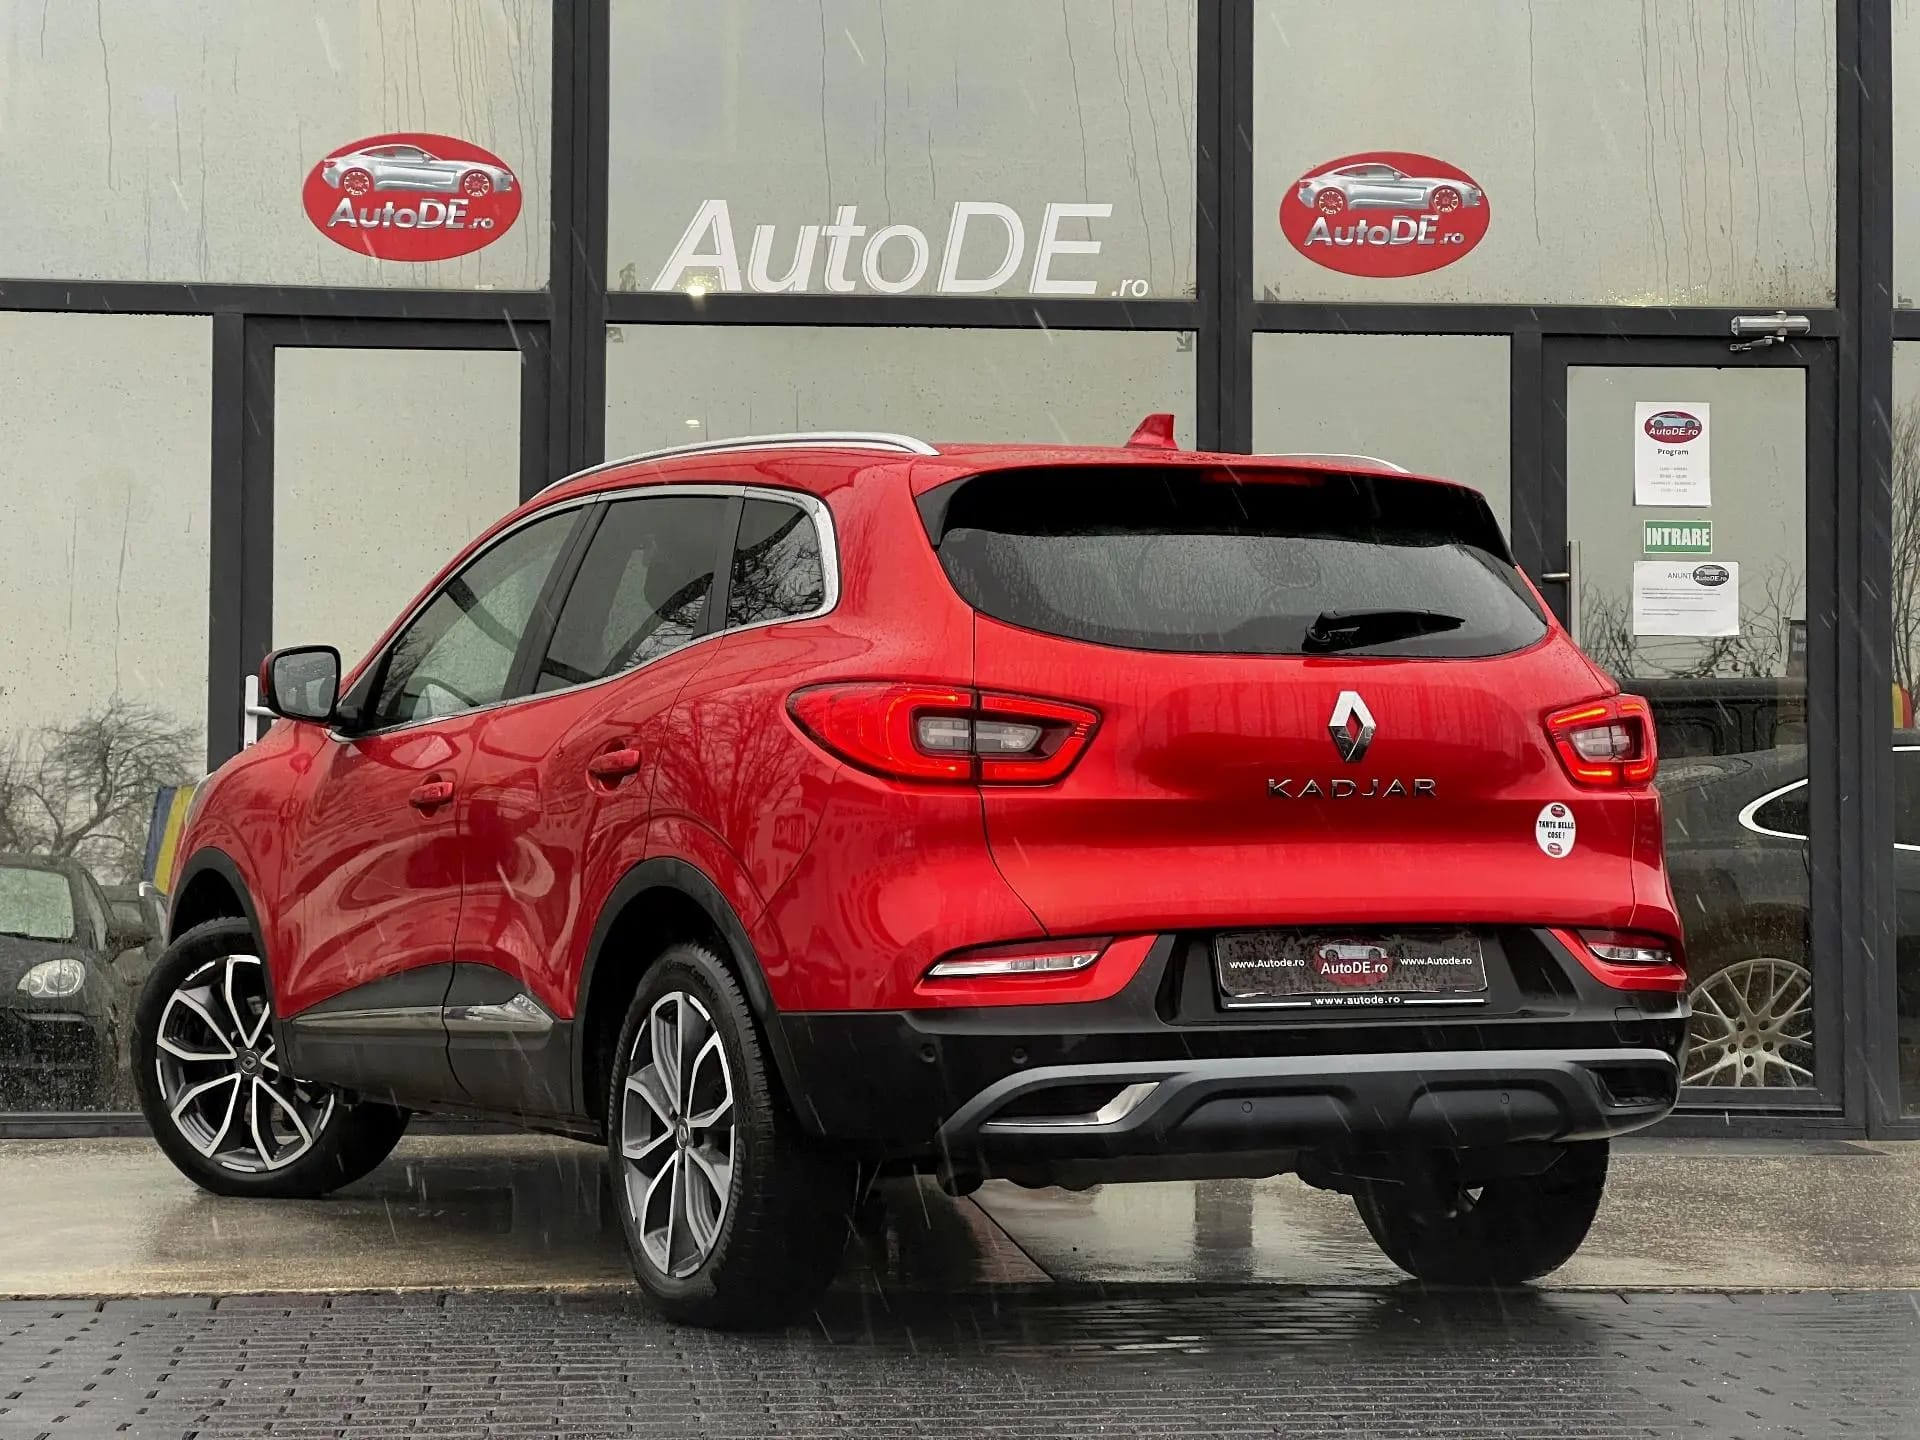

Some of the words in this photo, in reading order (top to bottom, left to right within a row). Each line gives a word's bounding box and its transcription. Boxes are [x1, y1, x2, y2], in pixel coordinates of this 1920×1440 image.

[1649, 427, 1699, 437] AutoDE.ro
[1657, 448, 1689, 457] Program
[1646, 527, 1710, 546] INTRARE
[1267, 777, 1438, 799] KADJAR
[1229, 957, 1305, 969] www.Autode.ro
[1400, 956, 1473, 966] www.Autode.ro
[1320, 961, 1388, 975] AutoDE.ro
[1314, 995, 1401, 1005] www.autode.ro
